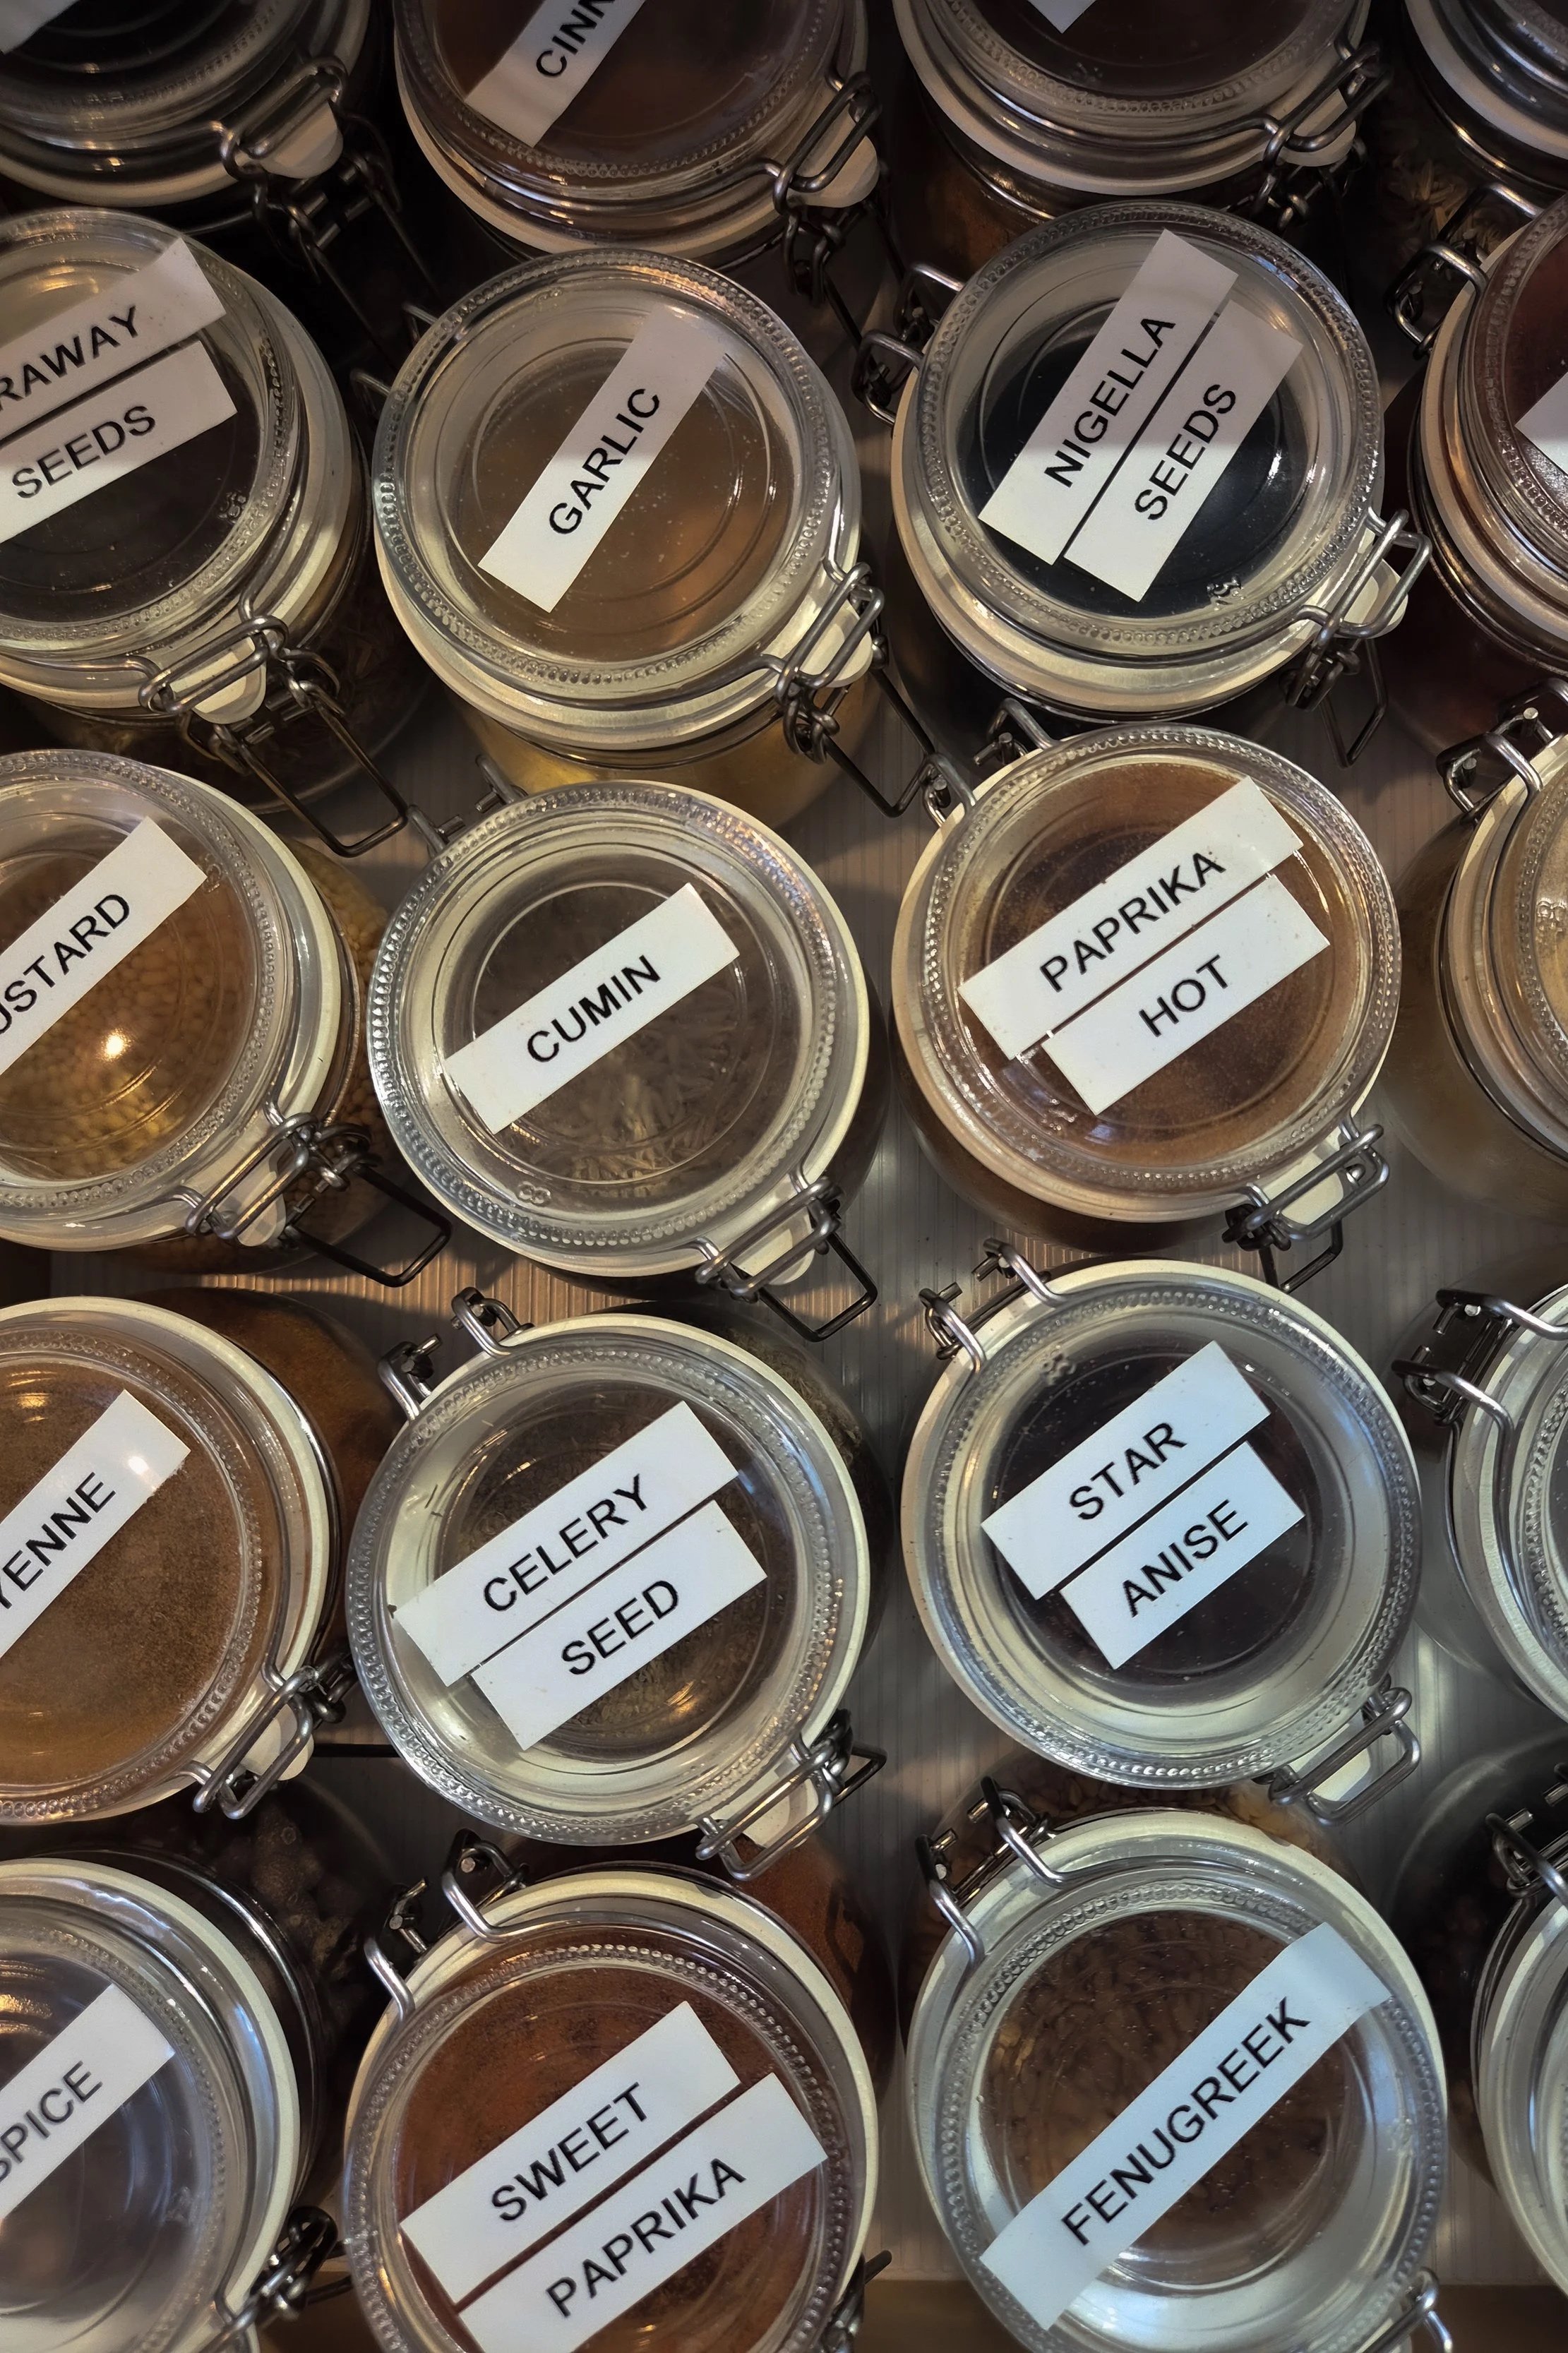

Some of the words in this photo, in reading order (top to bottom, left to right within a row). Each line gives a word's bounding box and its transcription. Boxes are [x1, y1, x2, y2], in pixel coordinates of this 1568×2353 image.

[12, 406, 155, 498] SEEDS
[549, 385, 659, 534] GARLIC
[1044, 318, 1175, 487] NIGELLA
[1135, 384, 1236, 520] SEEDS
[1040, 853, 1228, 992] PAPRIKA
[527, 955, 660, 1062] CUMIN
[1139, 954, 1228, 1037] HOT
[1070, 1423, 1187, 1520] STAR
[484, 1474, 647, 1611] CELERY
[1123, 1499, 1248, 1617] ANISE
[562, 1581, 678, 1675] SEED
[491, 2083, 647, 2221] SWEET
[1061, 1997, 1310, 2246] FENUGREEK
[546, 2159, 746, 2318] PAPRIKA
